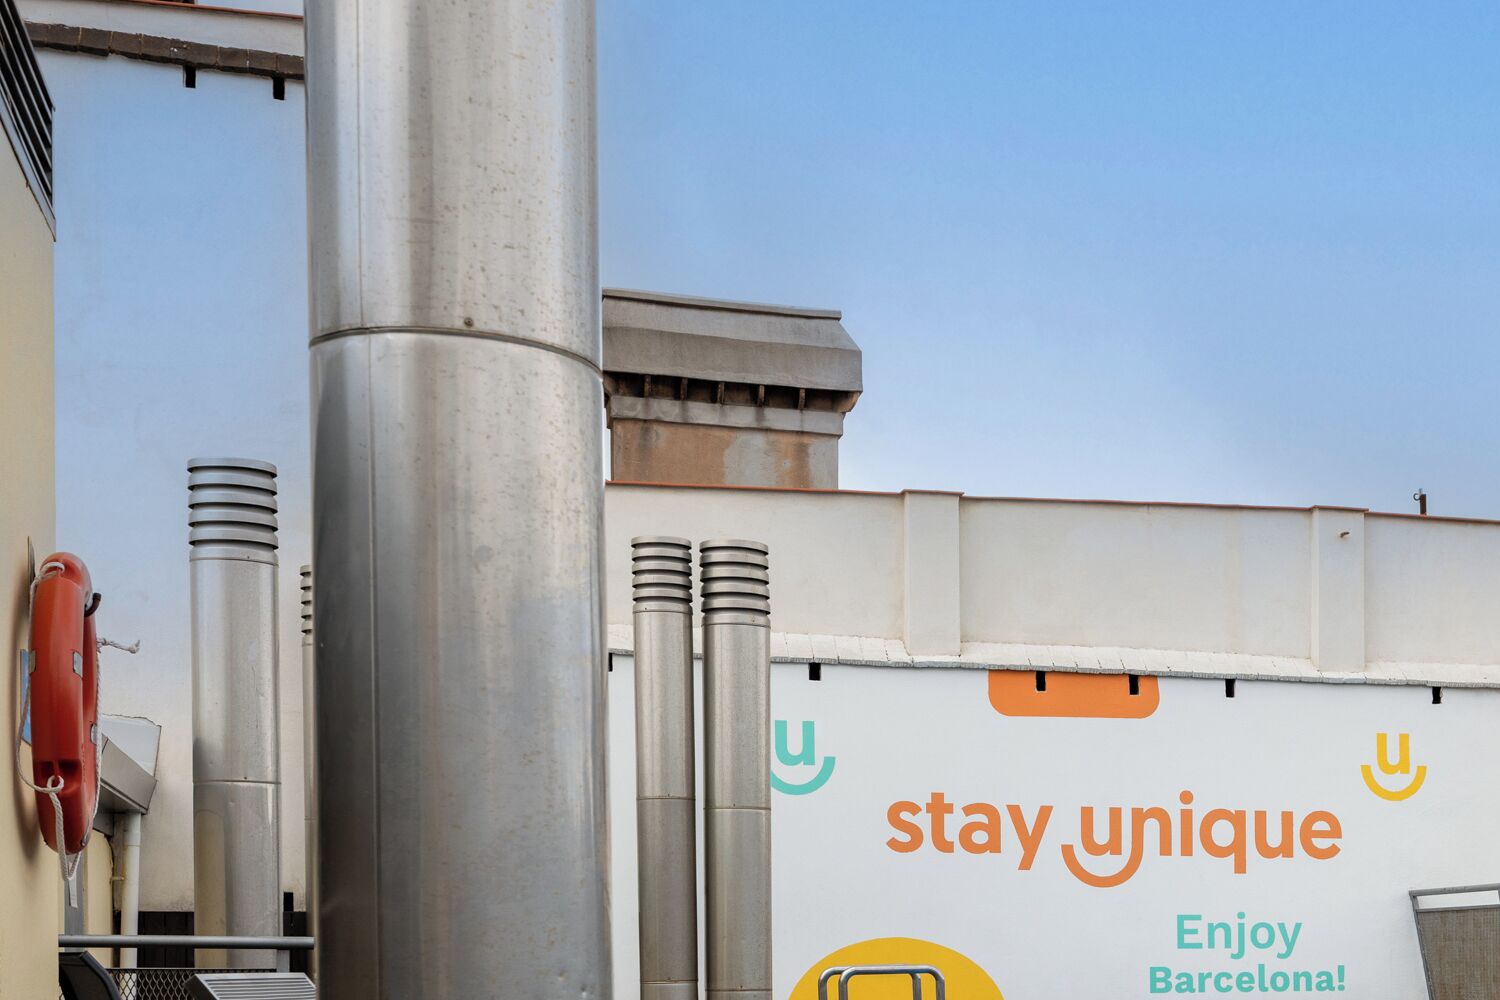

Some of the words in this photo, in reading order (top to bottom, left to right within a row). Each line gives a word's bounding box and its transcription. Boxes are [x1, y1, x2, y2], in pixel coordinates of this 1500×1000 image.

[886, 791, 1054, 871] stay
[1060, 789, 1343, 888] unique
[1176, 911, 1303, 960] Enjoy
[1148, 963, 1346, 994] Barcelona!
